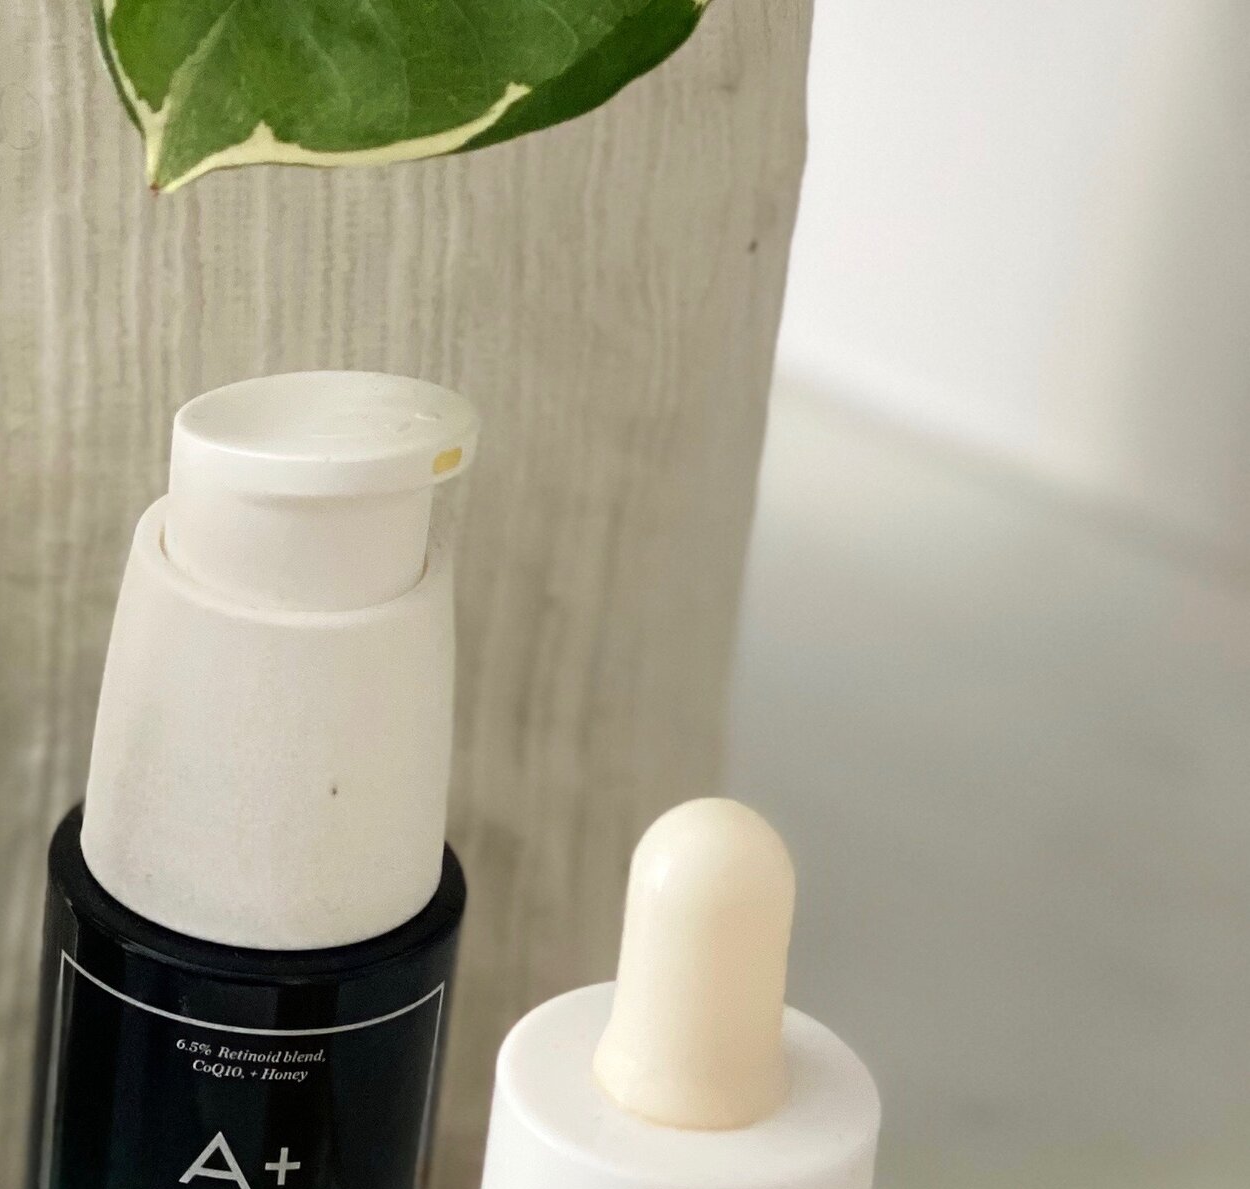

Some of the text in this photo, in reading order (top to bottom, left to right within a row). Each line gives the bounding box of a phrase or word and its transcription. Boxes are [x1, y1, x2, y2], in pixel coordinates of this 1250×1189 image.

[176, 1038, 212, 1056] 6.5%
[218, 1046, 282, 1063] Retinoid
[260, 1068, 308, 1082] Honey
